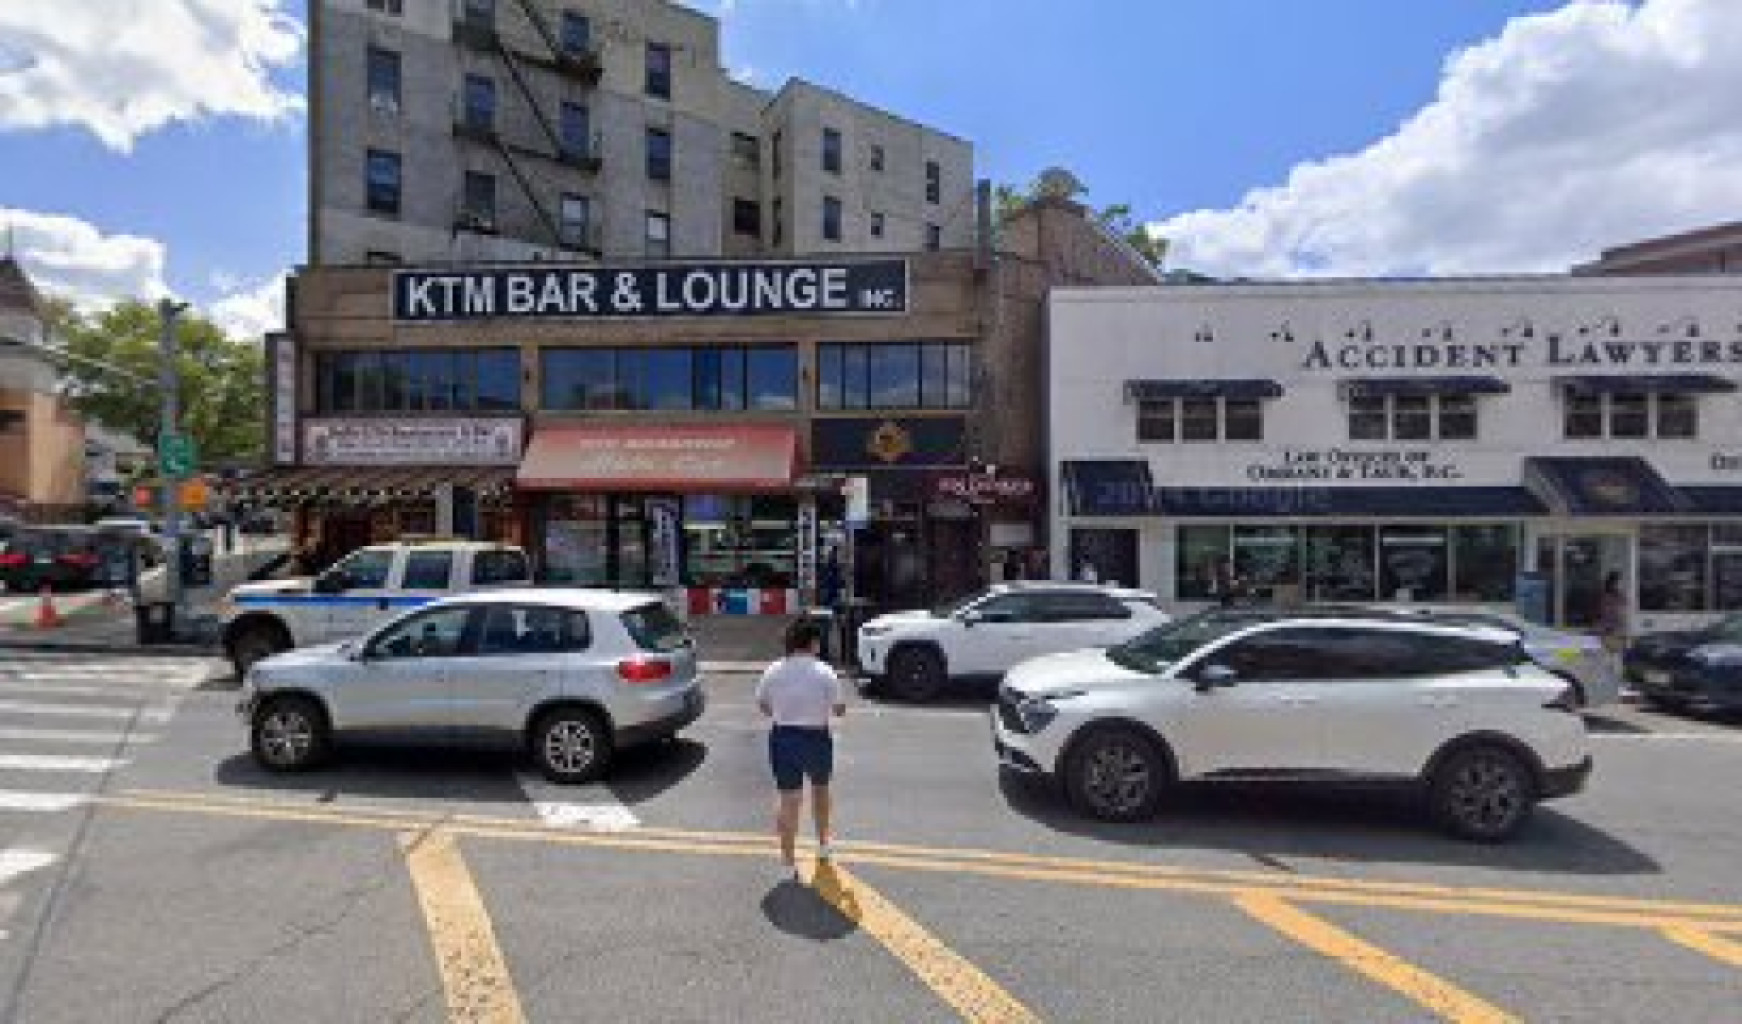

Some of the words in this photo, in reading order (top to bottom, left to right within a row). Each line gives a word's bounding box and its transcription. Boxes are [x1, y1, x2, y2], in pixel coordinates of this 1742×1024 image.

[408, 275, 496, 316] KTM
[506, 273, 600, 312] BAR
[610, 272, 644, 310] &
[655, 268, 849, 310] LOUNGE
[1302, 340, 1526, 369] ACCIDENT
[1546, 335, 1742, 364] LAWYERS
